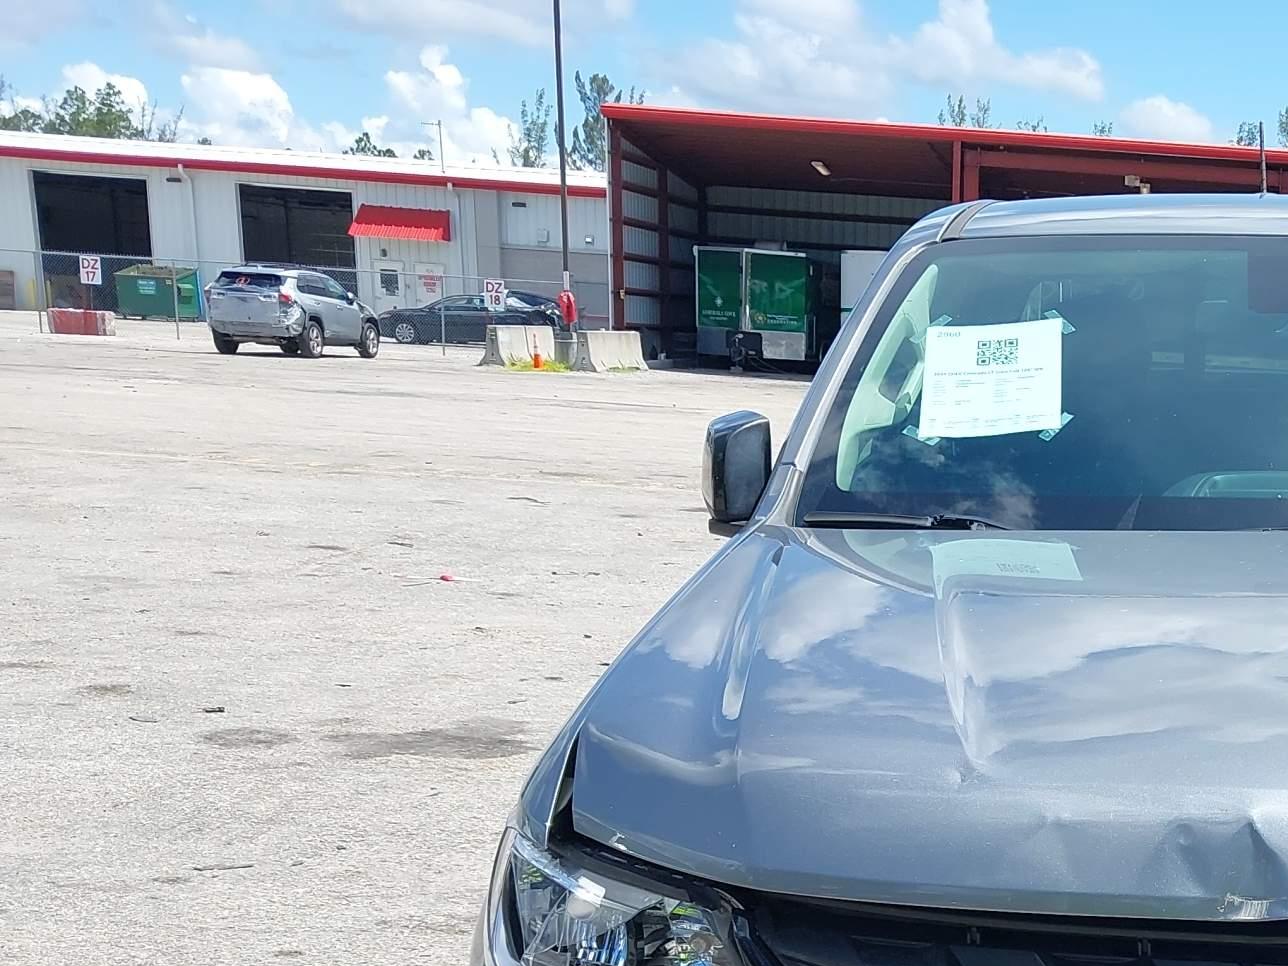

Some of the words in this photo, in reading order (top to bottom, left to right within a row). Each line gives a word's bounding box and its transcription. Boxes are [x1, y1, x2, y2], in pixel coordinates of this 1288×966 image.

[81, 258, 99, 270] DZ
[85, 271, 96, 282] 17
[485, 282, 503, 294] DZ
[488, 295, 501, 306] 18
